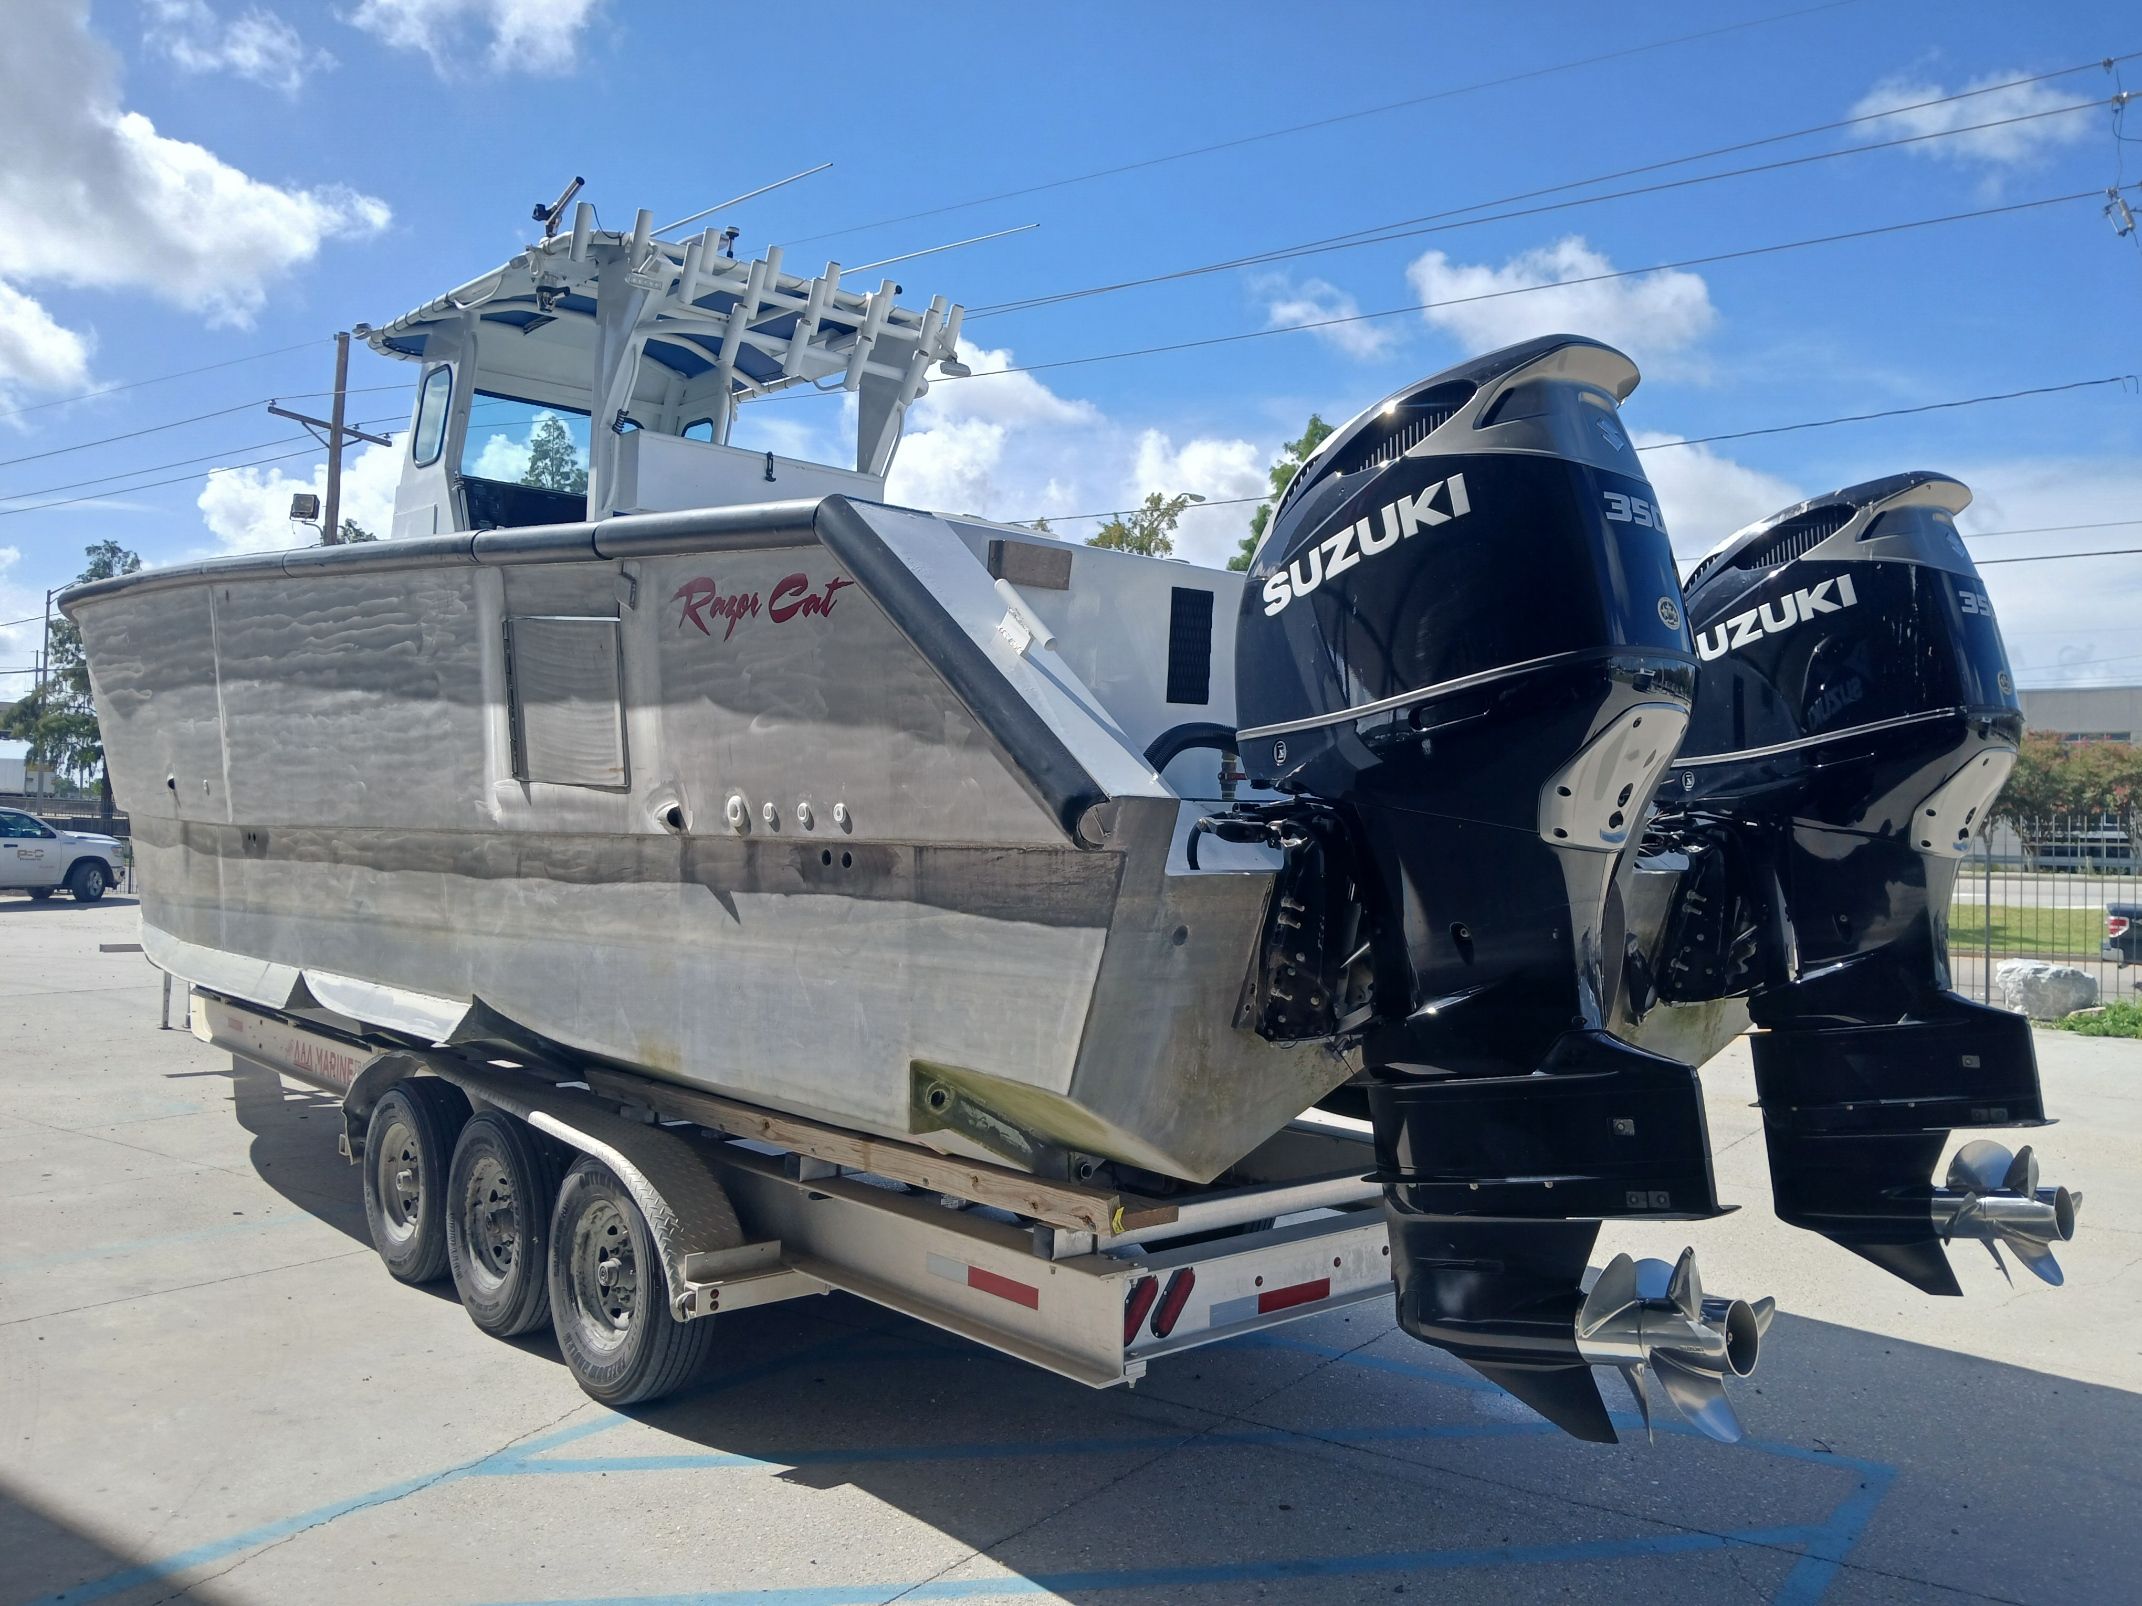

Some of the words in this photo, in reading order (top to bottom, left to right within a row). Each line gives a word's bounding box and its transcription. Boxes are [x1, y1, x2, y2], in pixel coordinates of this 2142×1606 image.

[1262, 473, 1472, 617] SUZUKI
[1603, 491, 1667, 535] 350
[670, 576, 762, 642] Razor
[768, 573, 855, 624] Cat
[1695, 573, 1858, 662] UZUKI
[1959, 590, 1996, 619] 35
